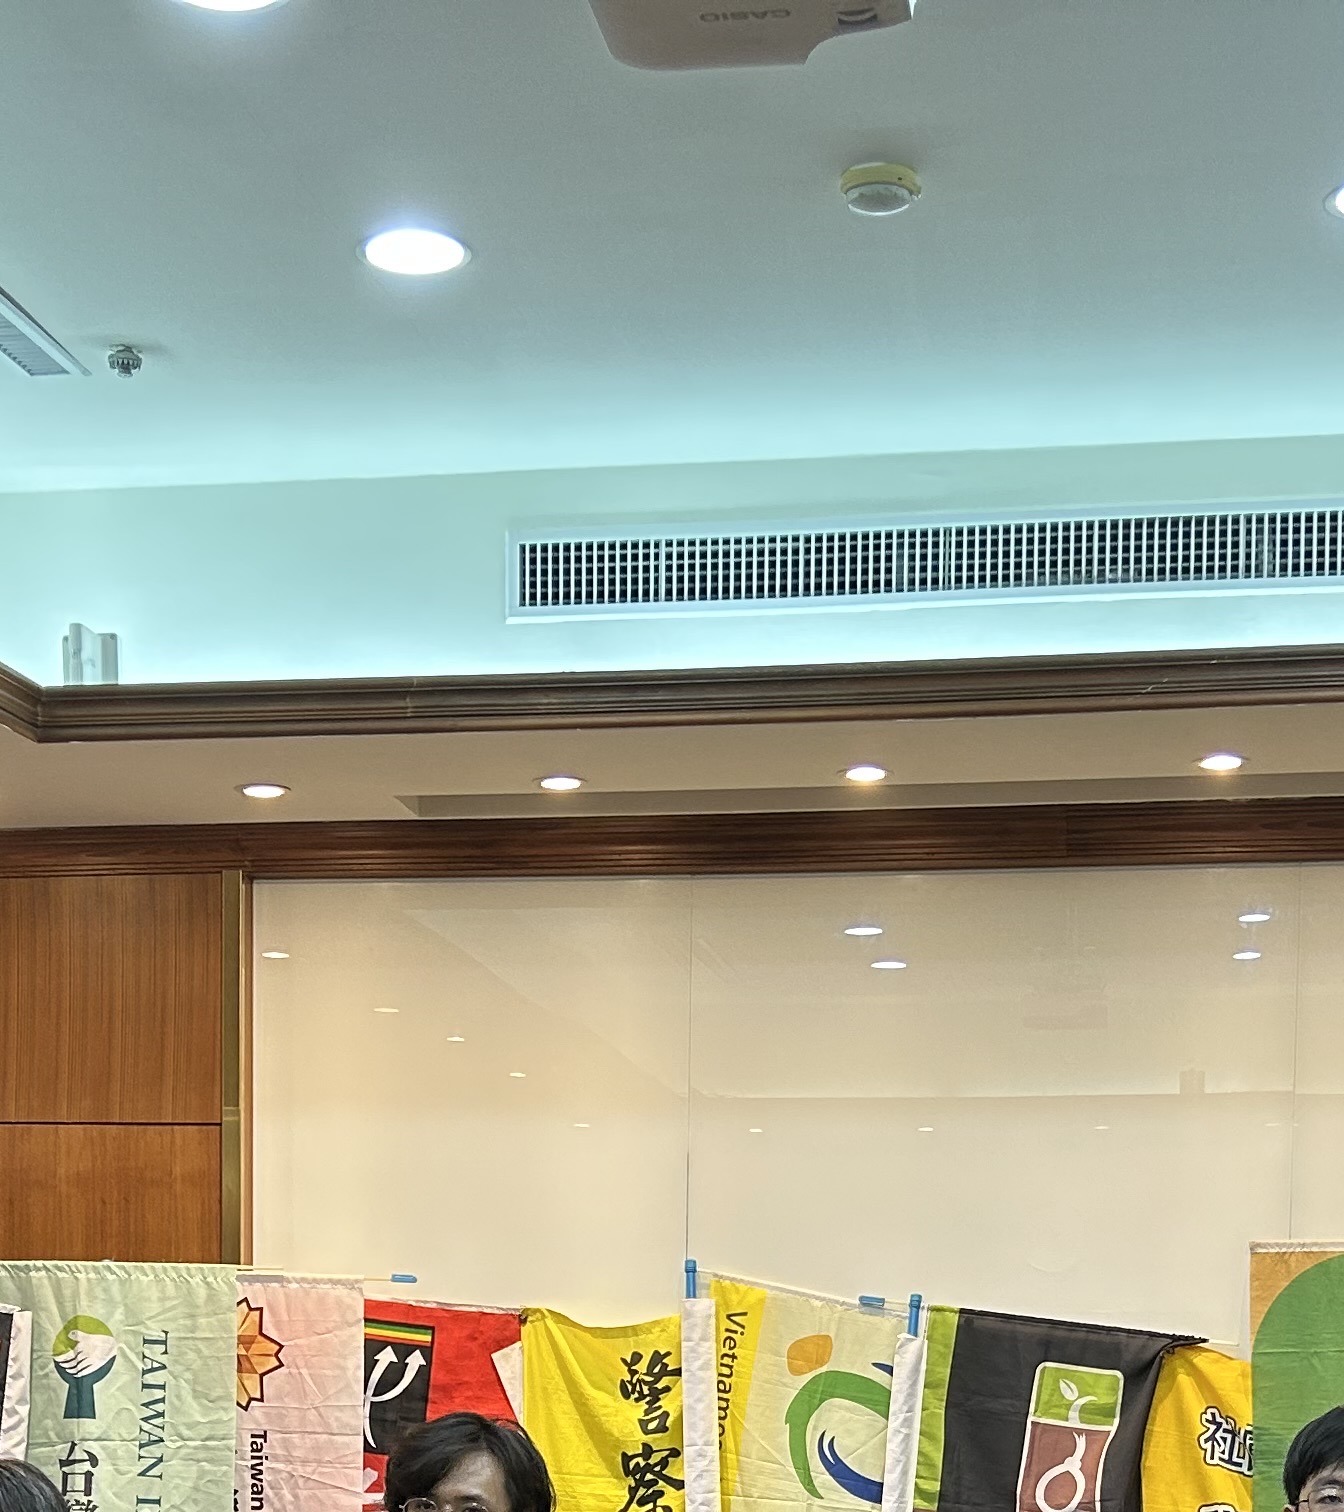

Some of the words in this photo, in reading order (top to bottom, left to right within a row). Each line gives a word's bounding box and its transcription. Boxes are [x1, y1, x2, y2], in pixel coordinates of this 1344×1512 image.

[699, 9, 791, 22] CASIO
[137, 1330, 169, 1481] TAIWAN
[249, 1430, 268, 1511] Taiwan
